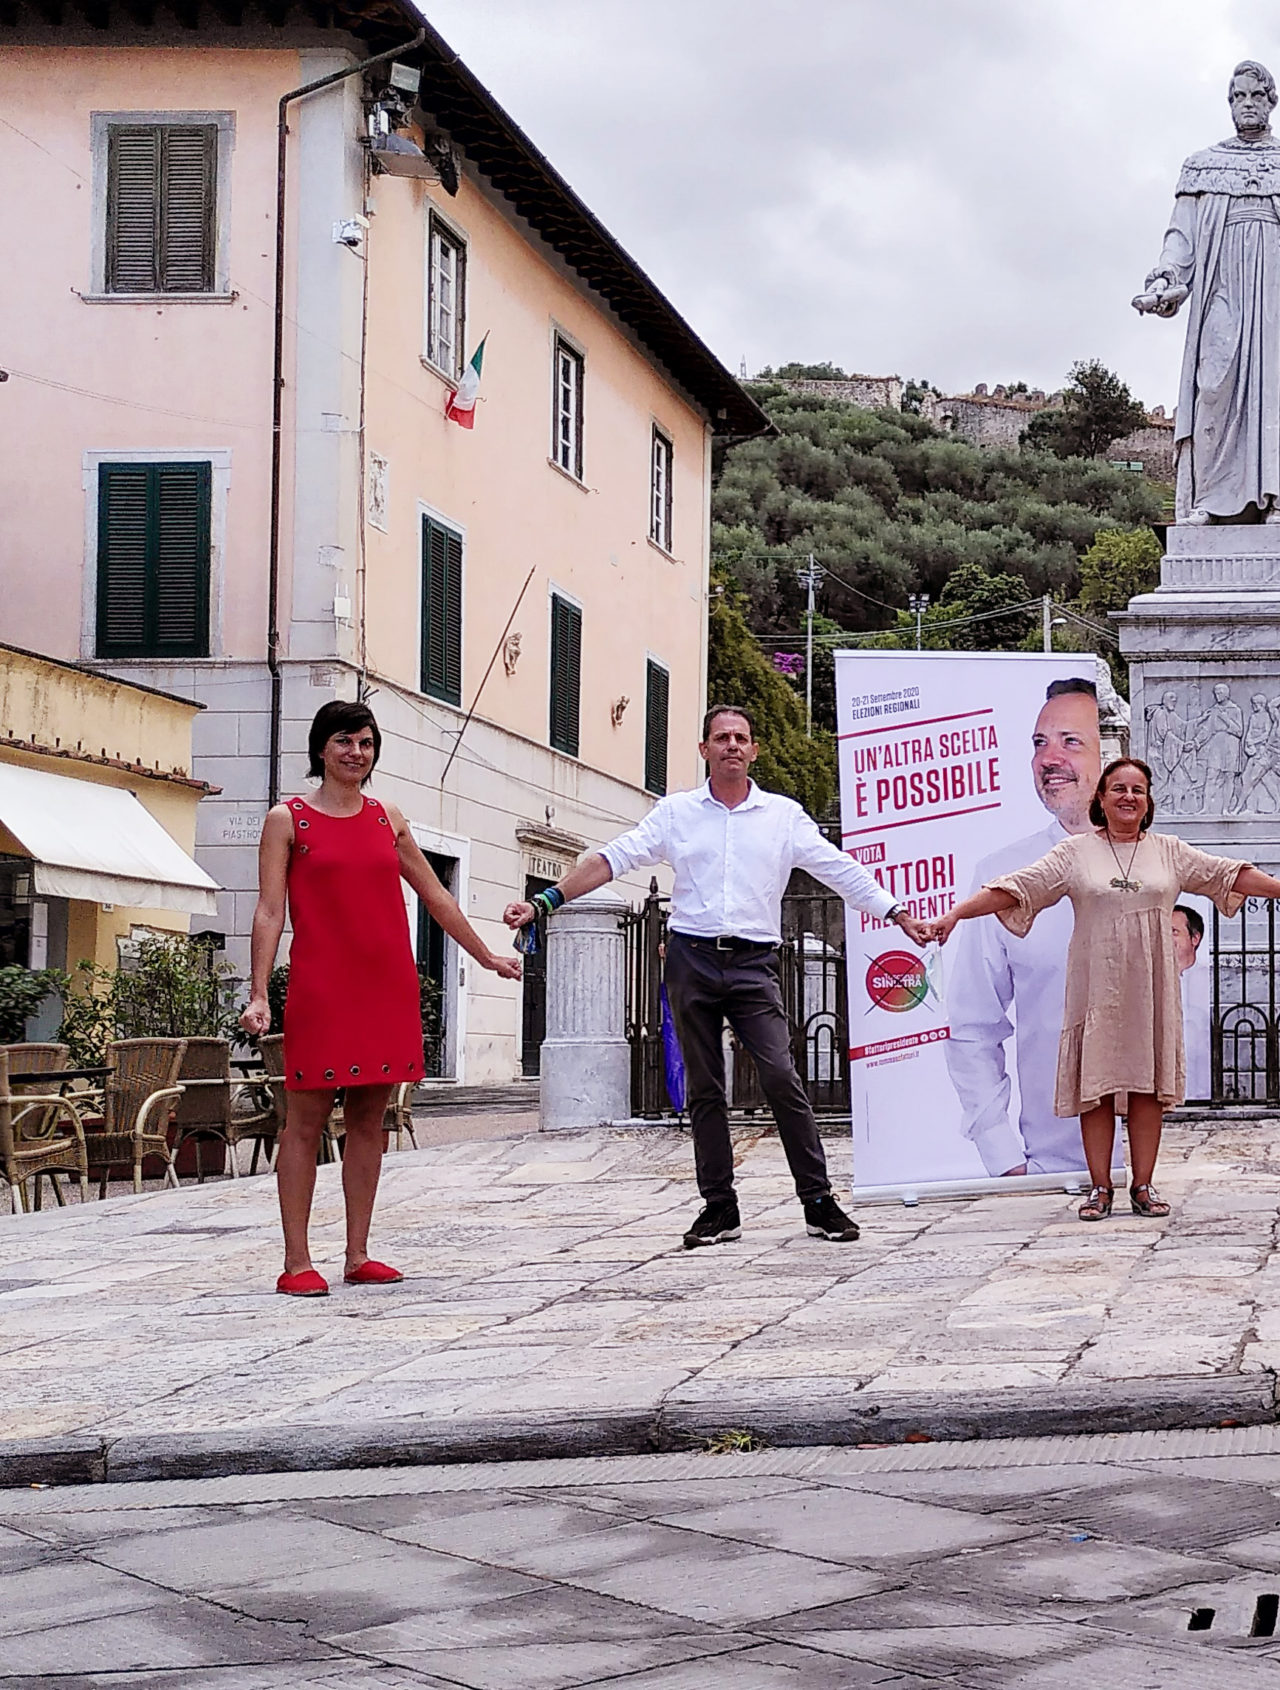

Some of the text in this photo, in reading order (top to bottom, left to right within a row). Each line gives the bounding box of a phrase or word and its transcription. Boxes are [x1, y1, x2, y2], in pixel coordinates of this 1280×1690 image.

[852, 695, 869, 707] 20-21
[903, 686, 920, 698] 2020
[852, 699, 920, 720] ELEZIONI REGIONALI
[854, 725, 998, 774] UN'ALTRA SCELTA
[856, 757, 1001, 817] È POSSIBILE
[857, 845, 883, 865] VOTA
[531, 857, 562, 878] TEATRO
[874, 853, 954, 898] ATTORI
